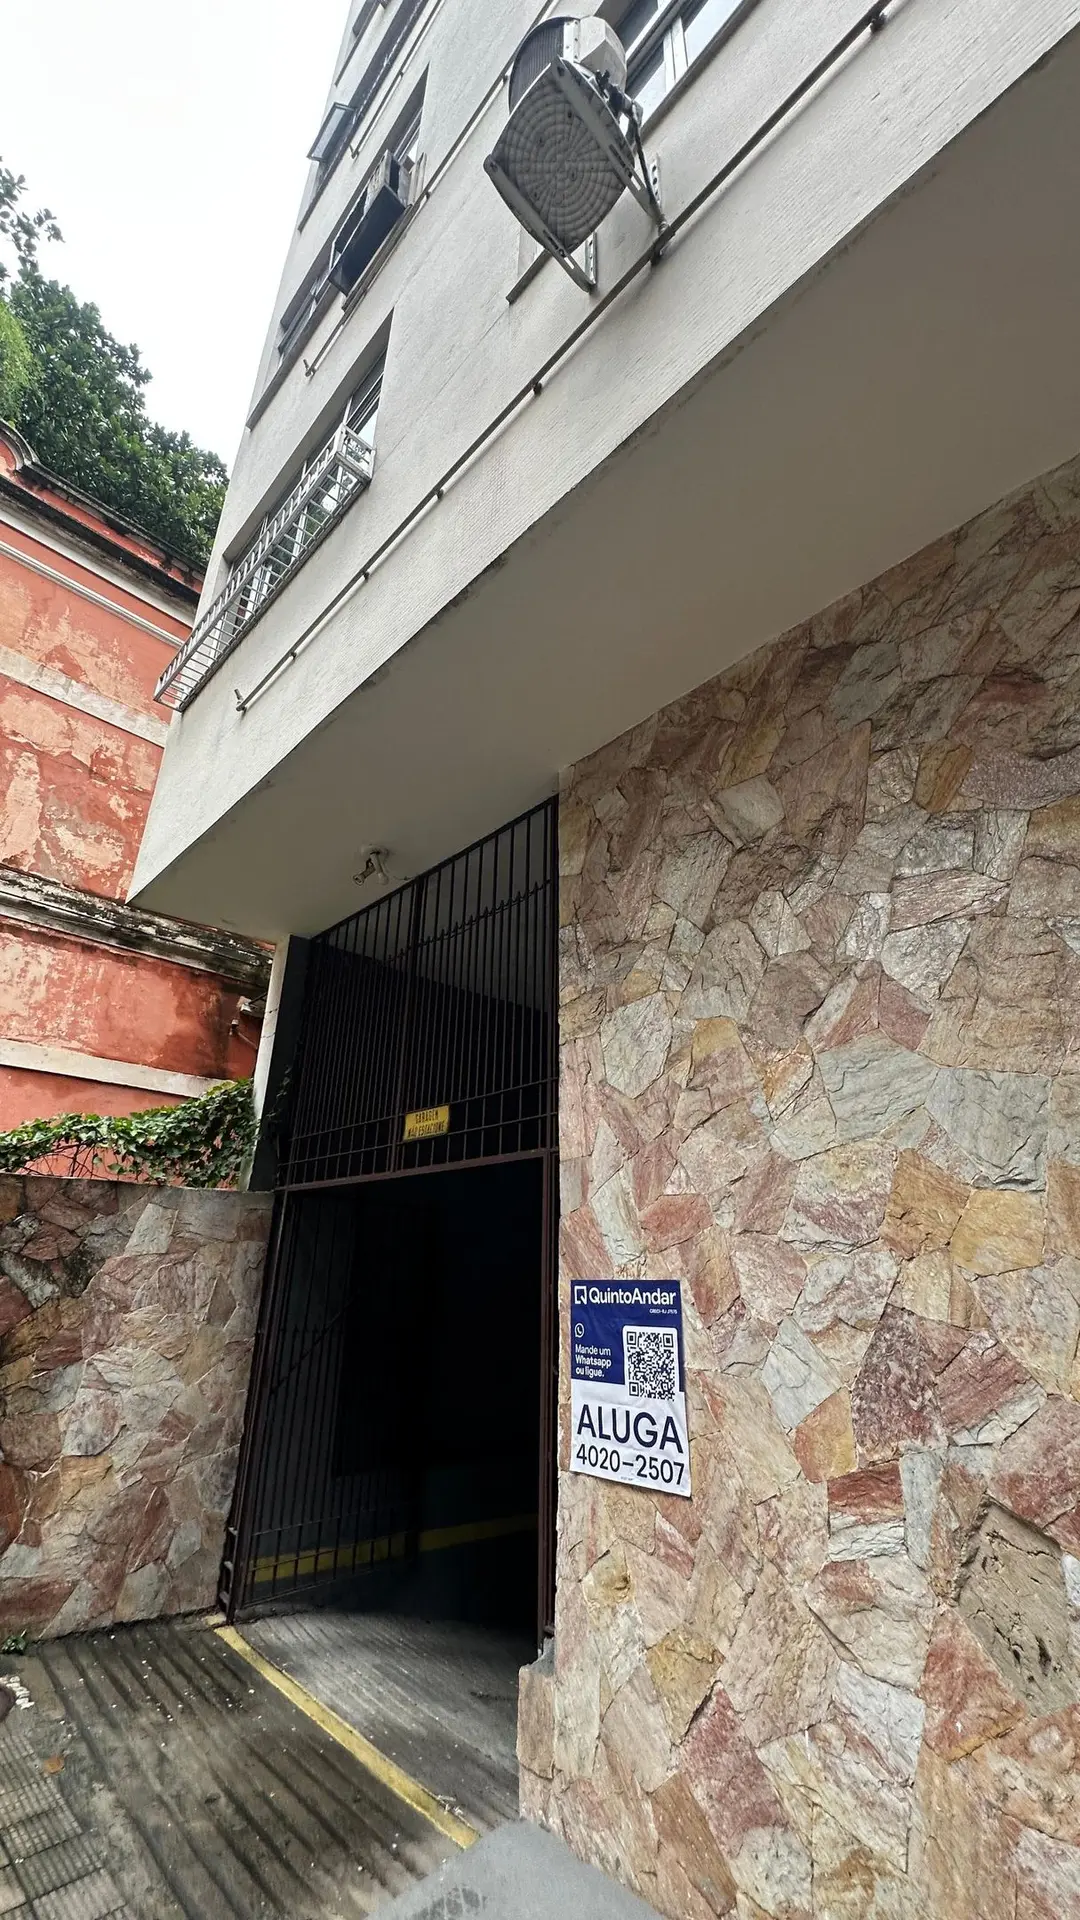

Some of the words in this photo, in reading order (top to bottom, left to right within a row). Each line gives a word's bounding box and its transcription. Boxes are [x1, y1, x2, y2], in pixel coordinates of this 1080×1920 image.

[589, 1286, 677, 1306] QuintoAndar
[575, 1344, 599, 1355] Mande
[599, 1347, 611, 1356] um
[575, 1354, 612, 1370] Whatsapp
[575, 1367, 585, 1376] ou
[585, 1366, 605, 1378] ligue.
[577, 1404, 684, 1454] ALUGA
[576, 1443, 685, 1485] 4020-2507
